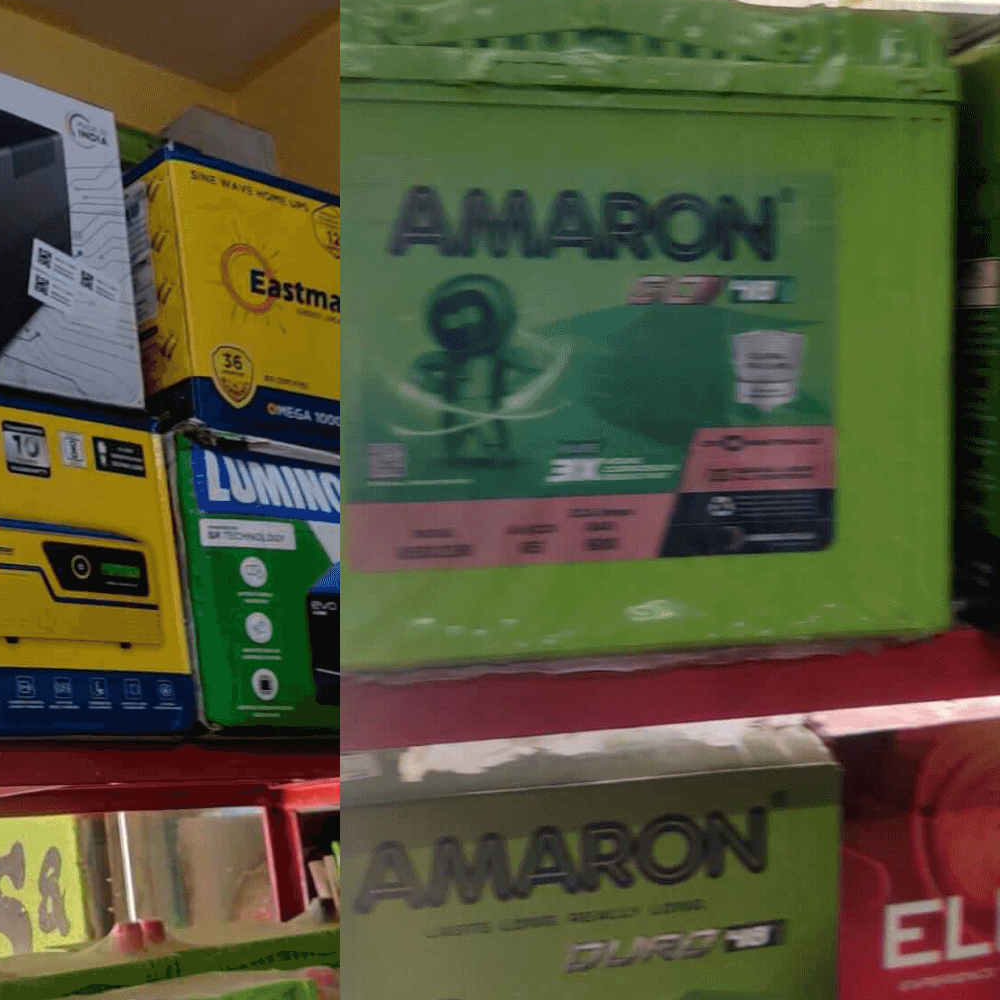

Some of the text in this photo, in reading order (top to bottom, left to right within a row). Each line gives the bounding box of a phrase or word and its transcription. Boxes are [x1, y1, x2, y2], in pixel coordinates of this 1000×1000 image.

[190, 170, 218, 187] SINE
[221, 177, 253, 197] WAVE
[384, 184, 781, 263] AMARON
[222, 353, 243, 371] 36
[352, 804, 768, 916] AMARON
